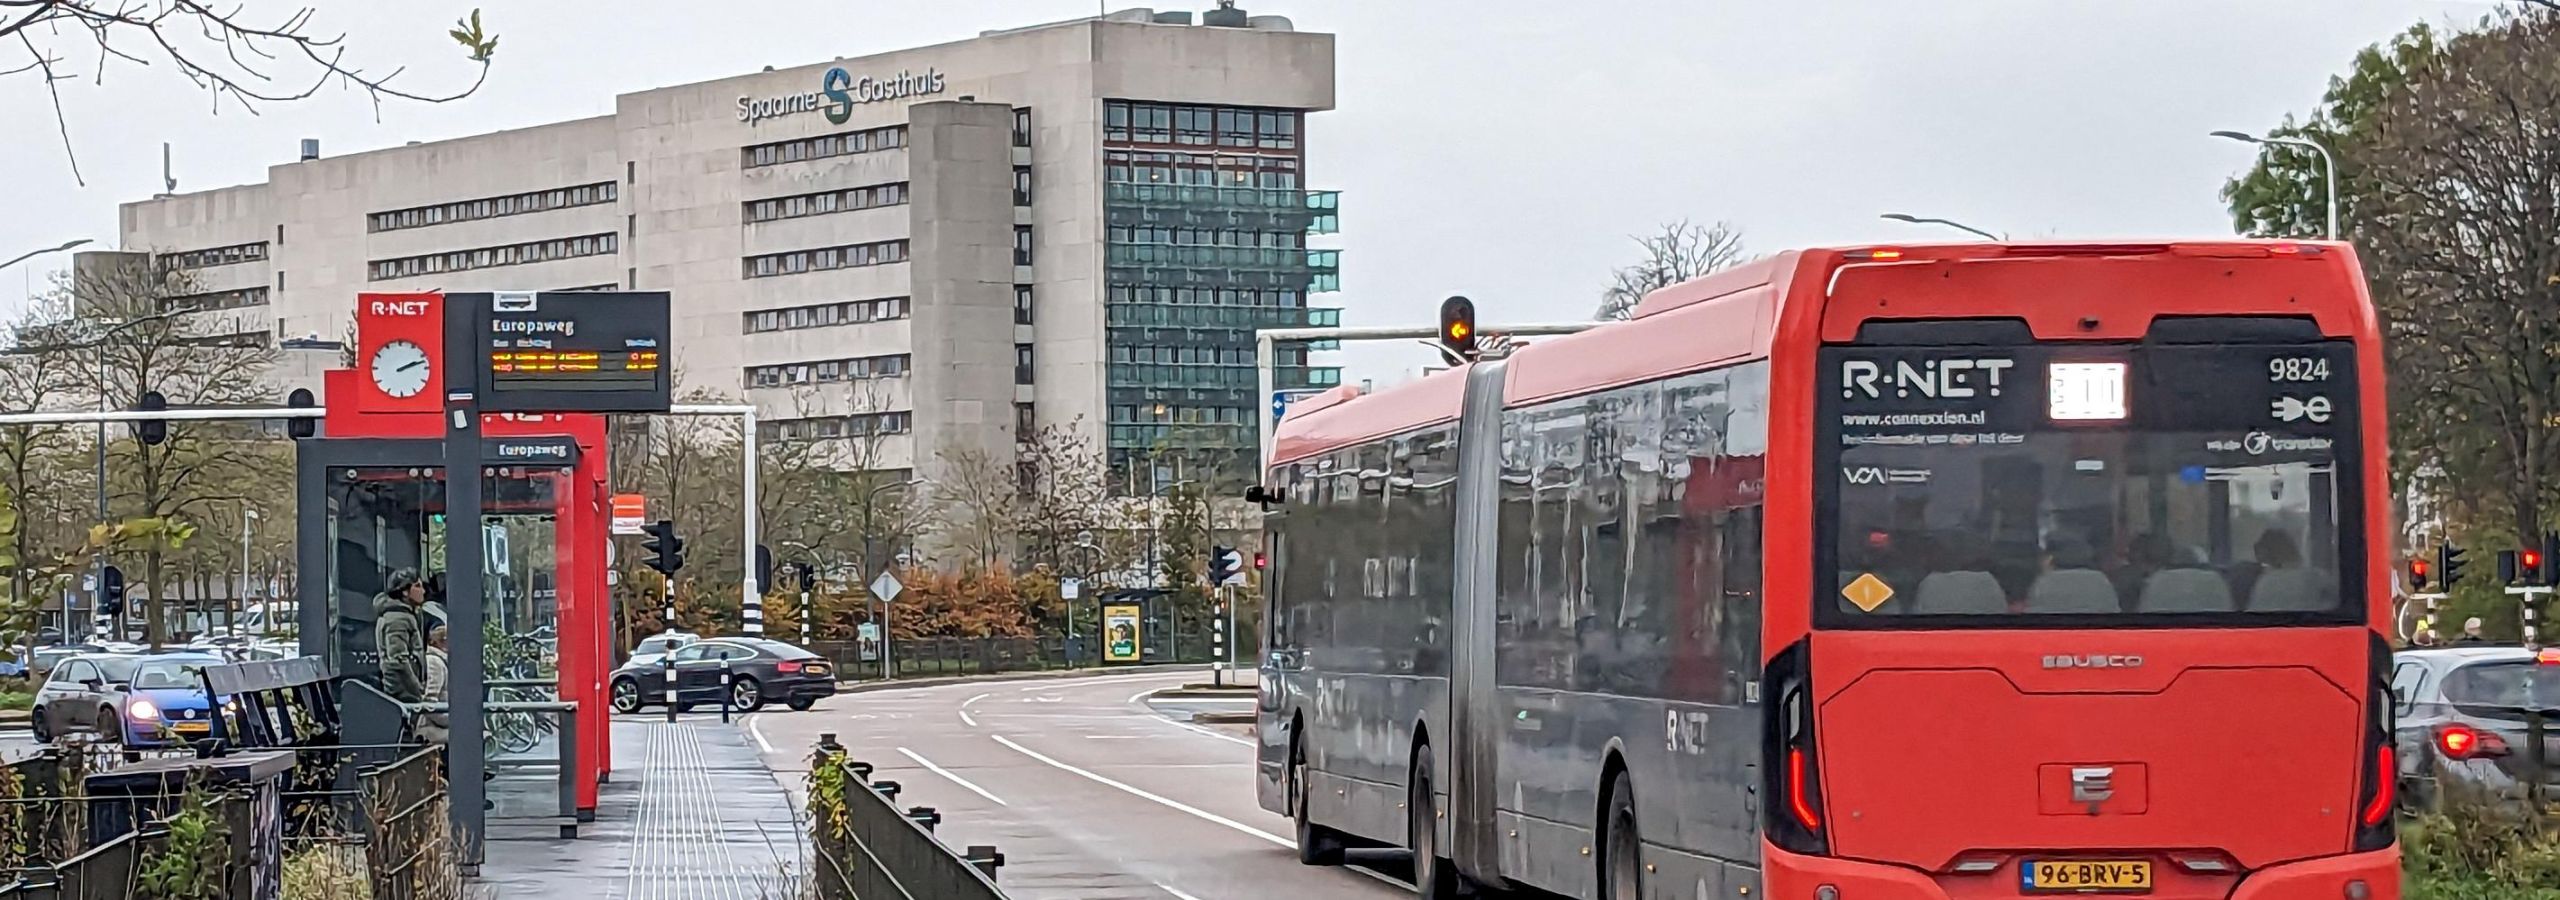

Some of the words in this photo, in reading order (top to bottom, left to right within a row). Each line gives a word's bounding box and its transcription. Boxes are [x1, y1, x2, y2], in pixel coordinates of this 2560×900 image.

[736, 90, 818, 127] Spaarne
[856, 66, 945, 103] Gasthuis
[492, 319, 575, 337] Europaweg
[2269, 358, 2330, 382] 9824
[498, 444, 568, 458] Europaweg
[2041, 864, 2144, 883] 96-BRV-5
